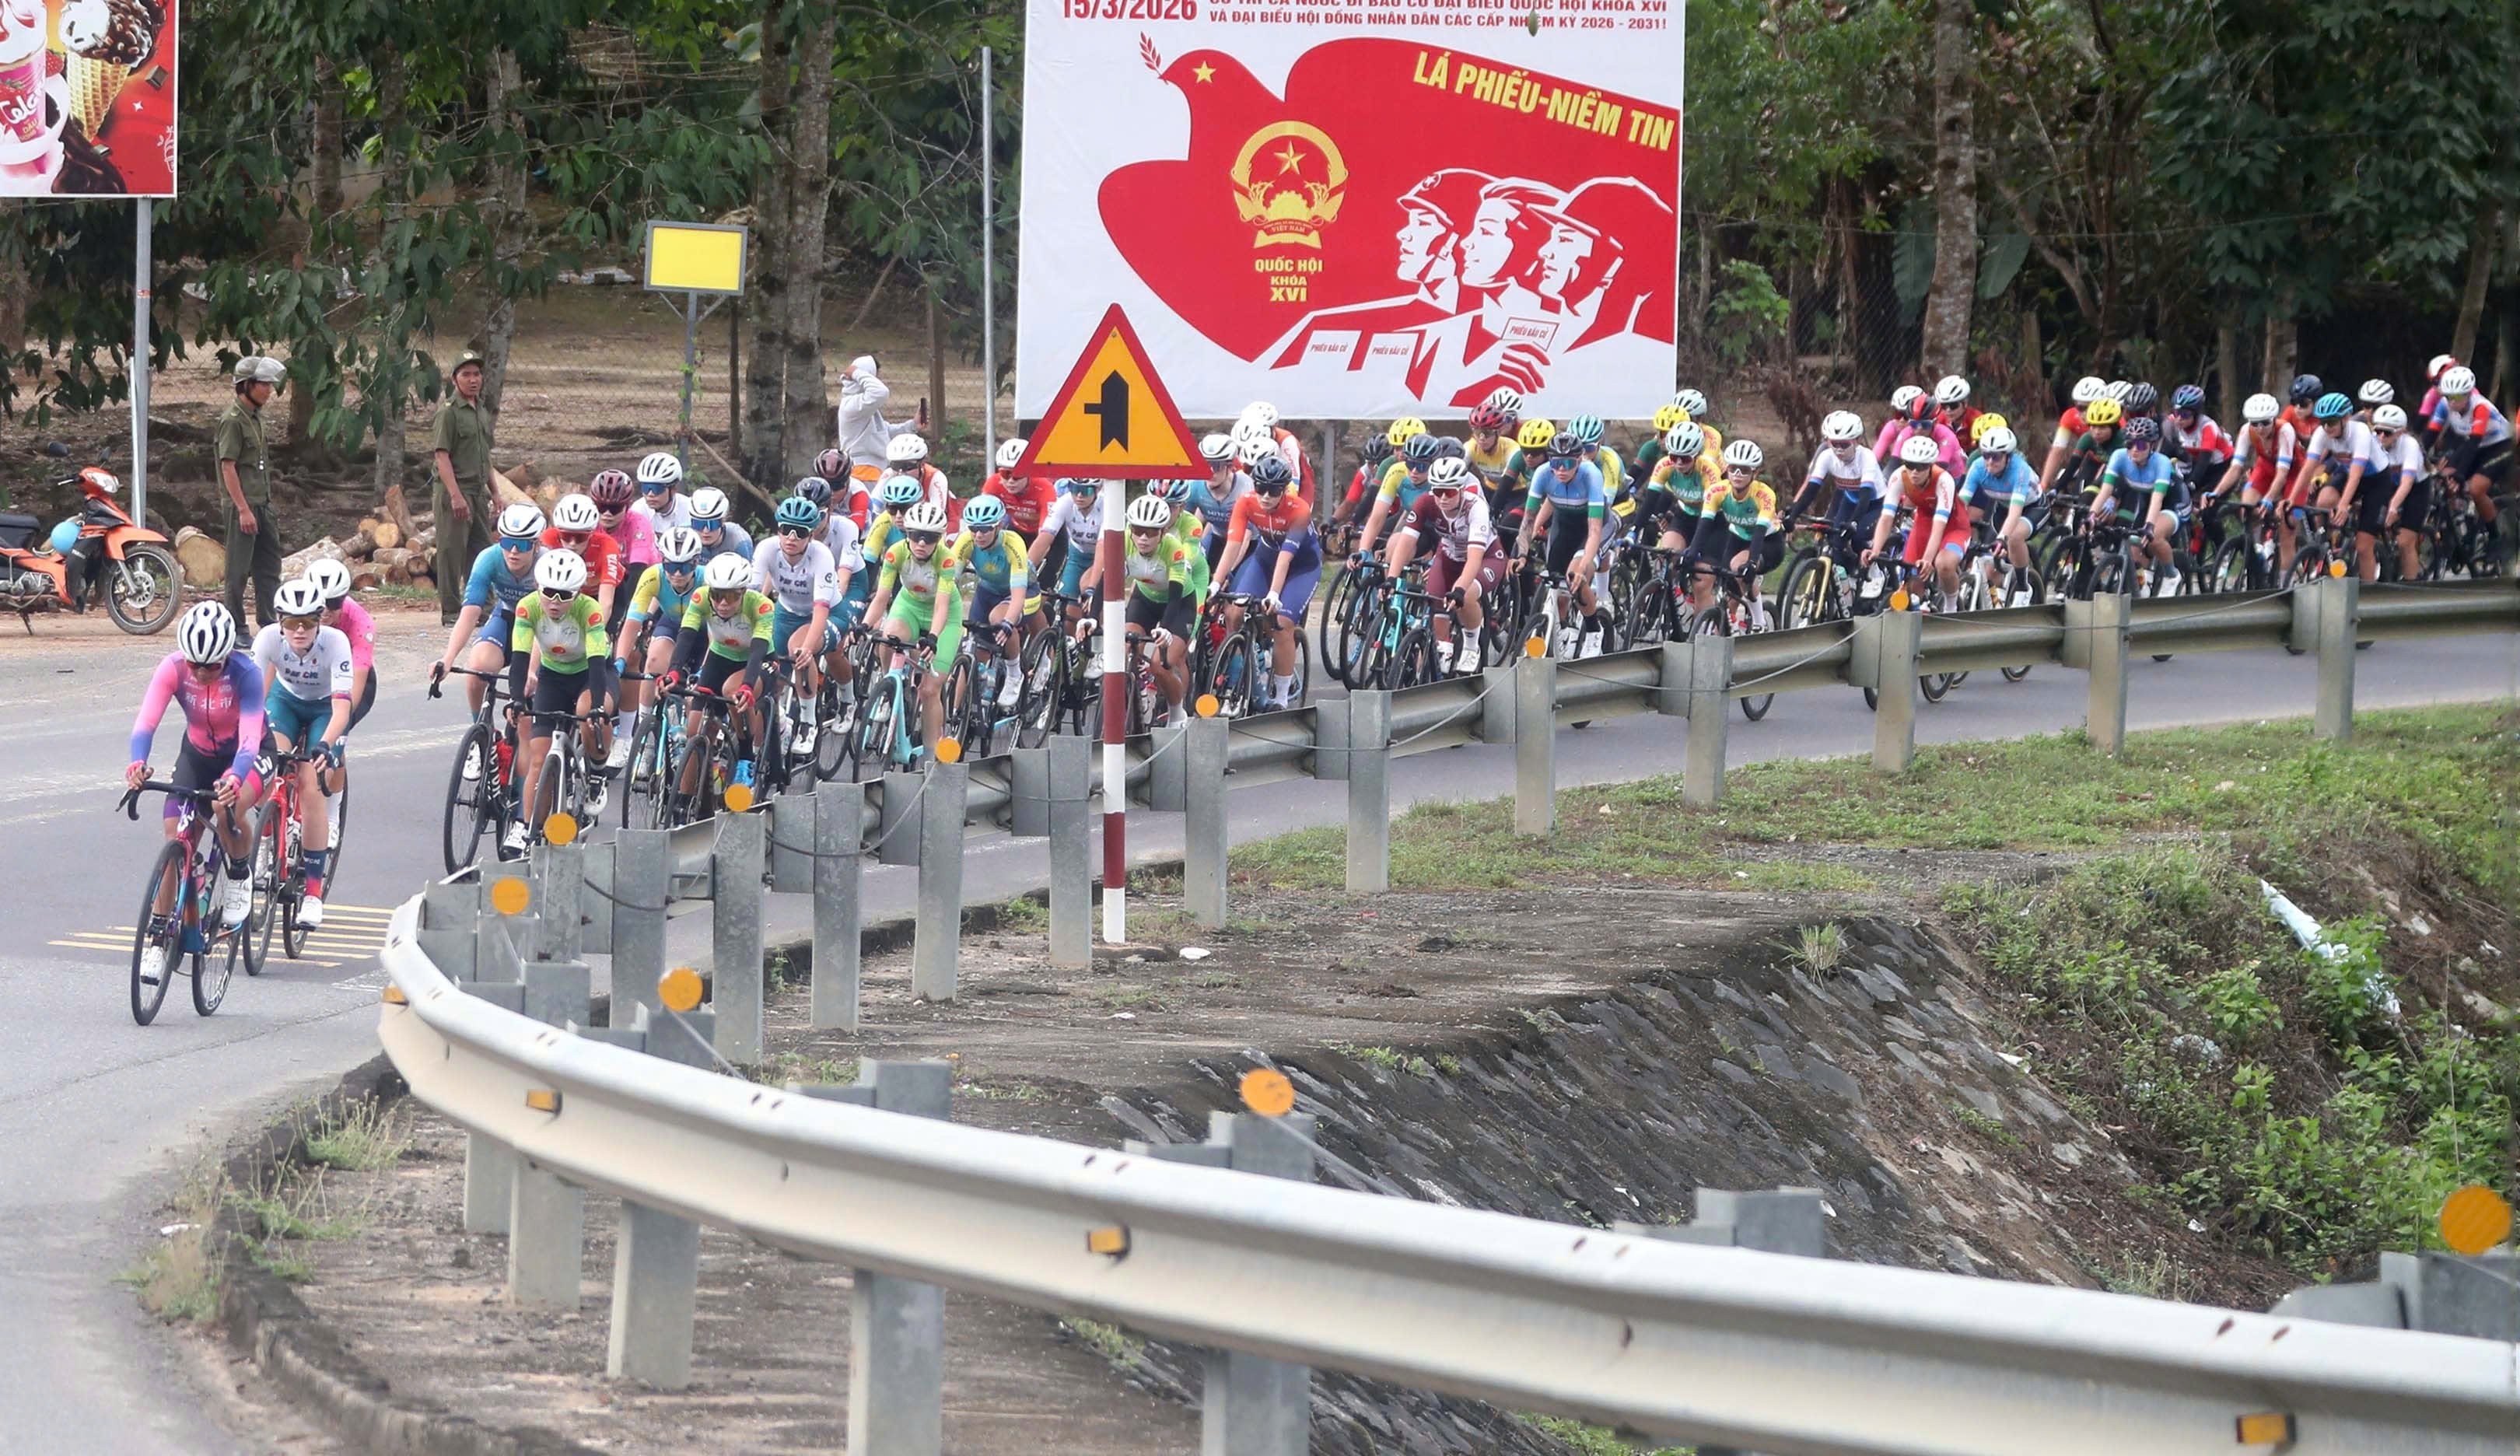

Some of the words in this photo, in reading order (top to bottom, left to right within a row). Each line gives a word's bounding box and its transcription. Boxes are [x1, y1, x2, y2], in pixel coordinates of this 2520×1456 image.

[1641, 0, 1667, 12] XVI
[1232, 11, 1255, 25] ĐẠI
[1297, 10, 1320, 26] HỘI
[1367, 11, 1406, 25] NHÂN
[1411, 12, 1440, 25] DÂN
[1444, 12, 1472, 26] CÁC
[1477, 11, 1504, 26] CẤP
[1581, 17, 1614, 28] 2026
[1629, 18, 1666, 29] 2031!
[1413, 51, 1451, 89] LÁ
[1628, 110, 1675, 151] TIN
[1255, 255, 1294, 272] QUỐC
[1297, 257, 1323, 274] HỘI
[1270, 275, 1307, 285] KHÓA
[1270, 287, 1307, 302] XVI
